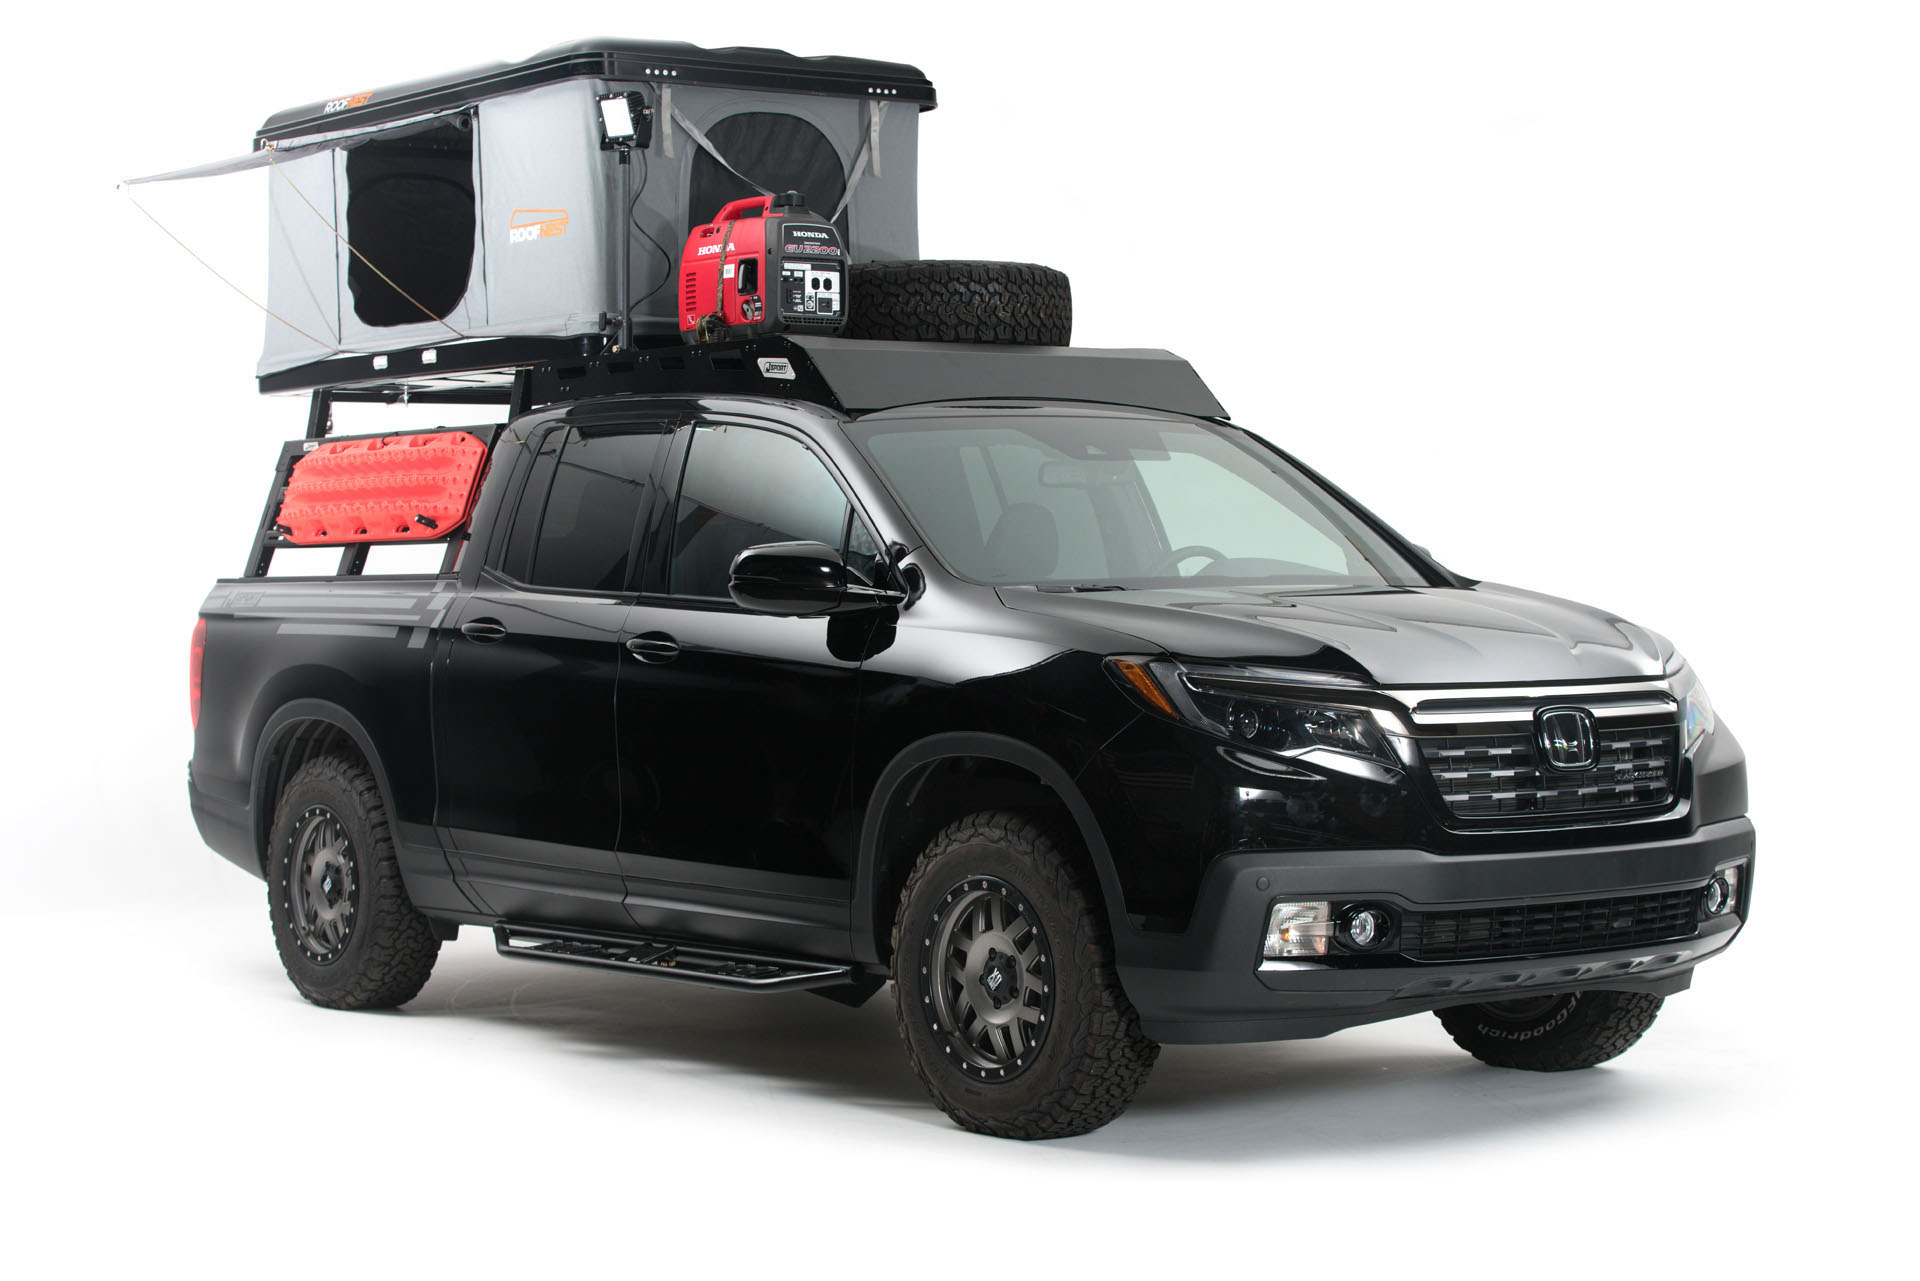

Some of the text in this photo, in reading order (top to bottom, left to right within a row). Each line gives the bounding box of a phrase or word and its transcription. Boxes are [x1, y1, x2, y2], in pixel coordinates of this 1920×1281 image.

[323, 94, 374, 114] ROOFNEST
[509, 221, 569, 244] ROOFNEST
[792, 231, 829, 239] HONDA
[697, 243, 736, 256] HONA
